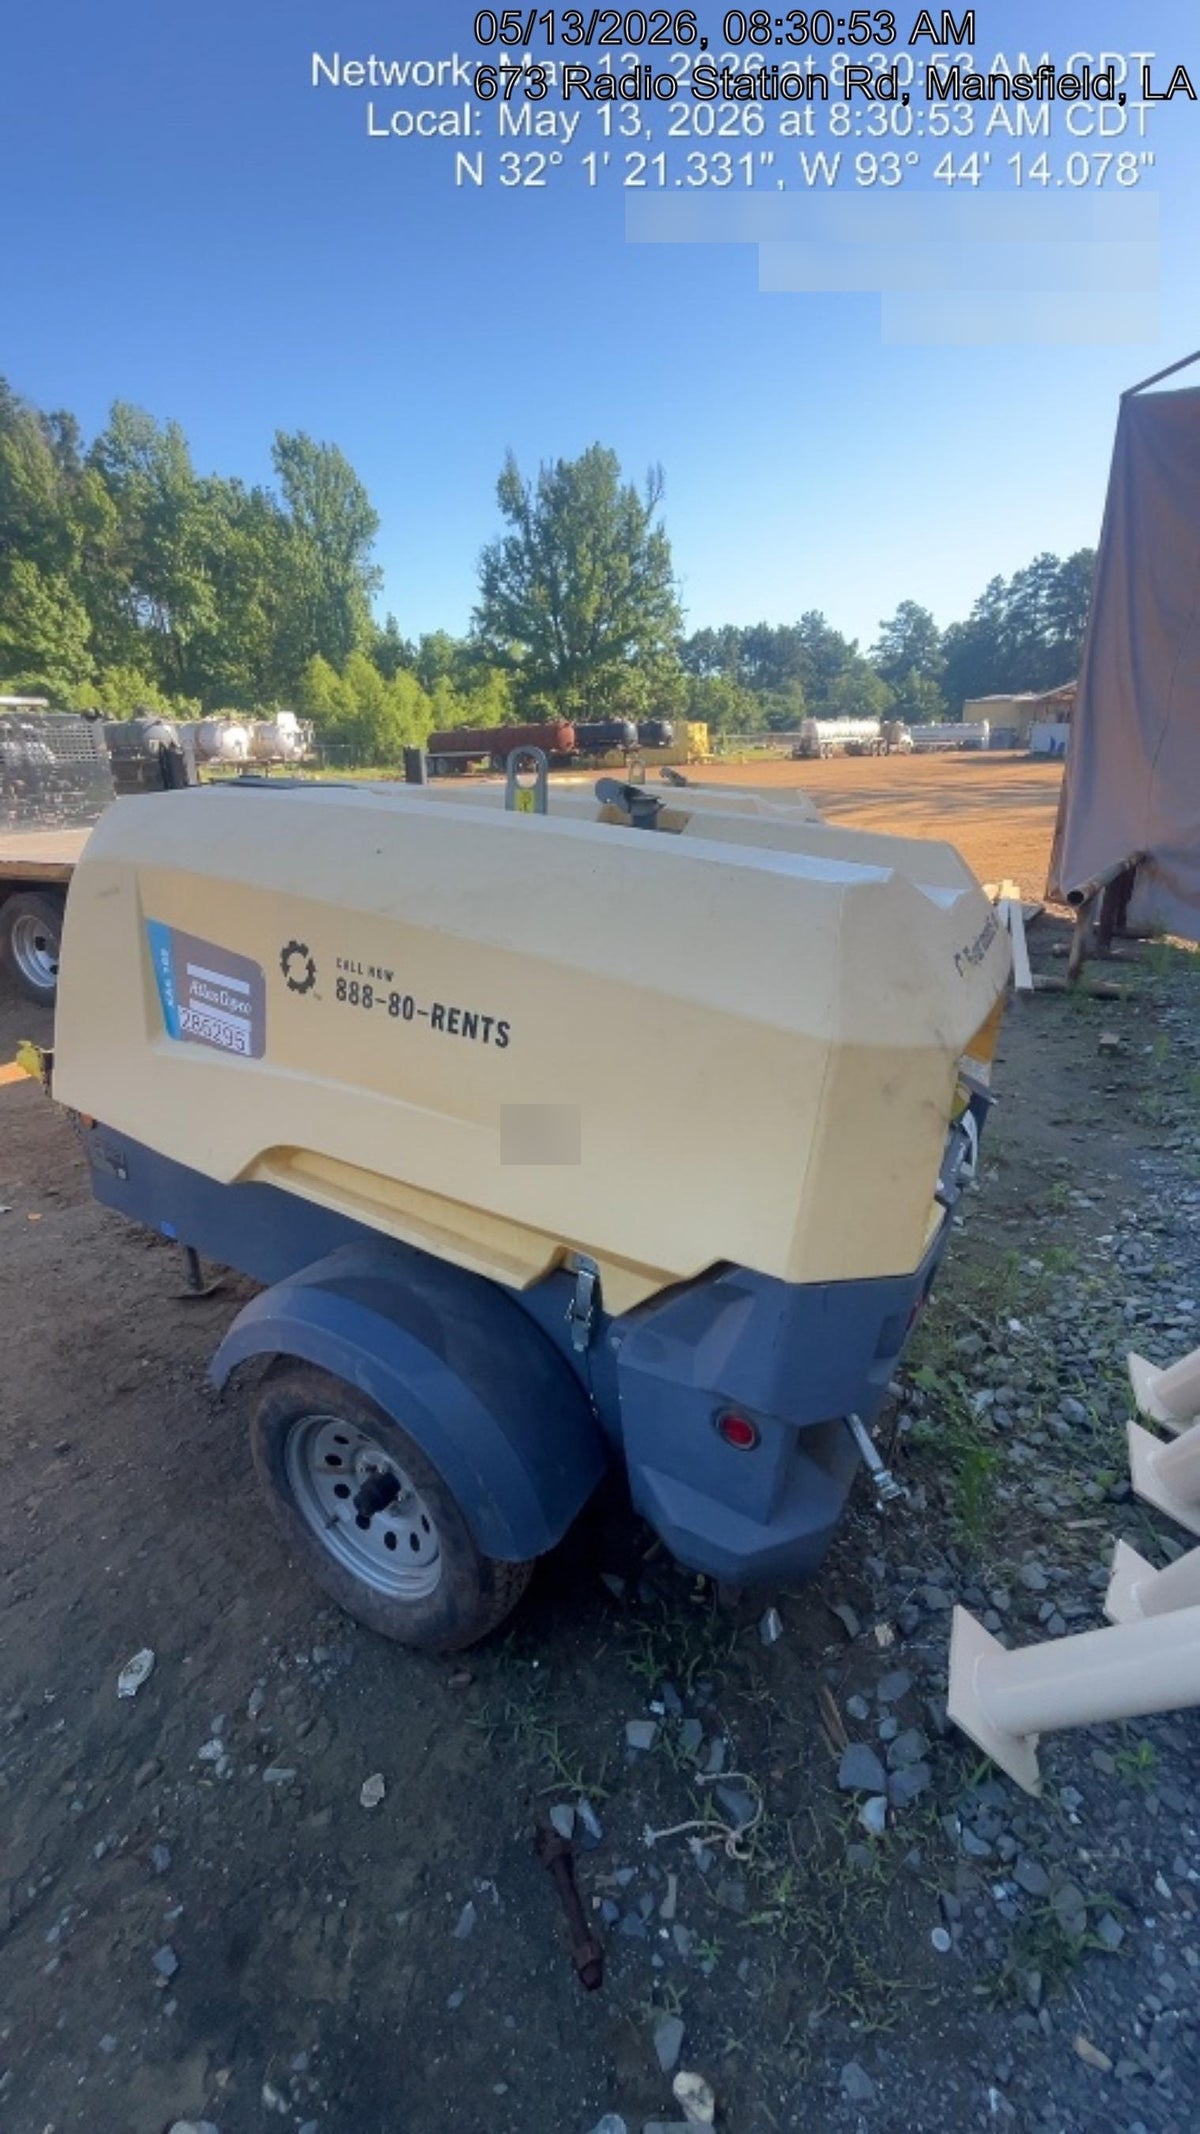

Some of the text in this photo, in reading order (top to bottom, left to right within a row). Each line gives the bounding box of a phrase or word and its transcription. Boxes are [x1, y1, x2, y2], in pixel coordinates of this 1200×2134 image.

[336, 957, 394, 982] CALL NOW
[189, 980, 219, 1002] Atlas
[336, 977, 511, 1049] 888-80-RENTS
